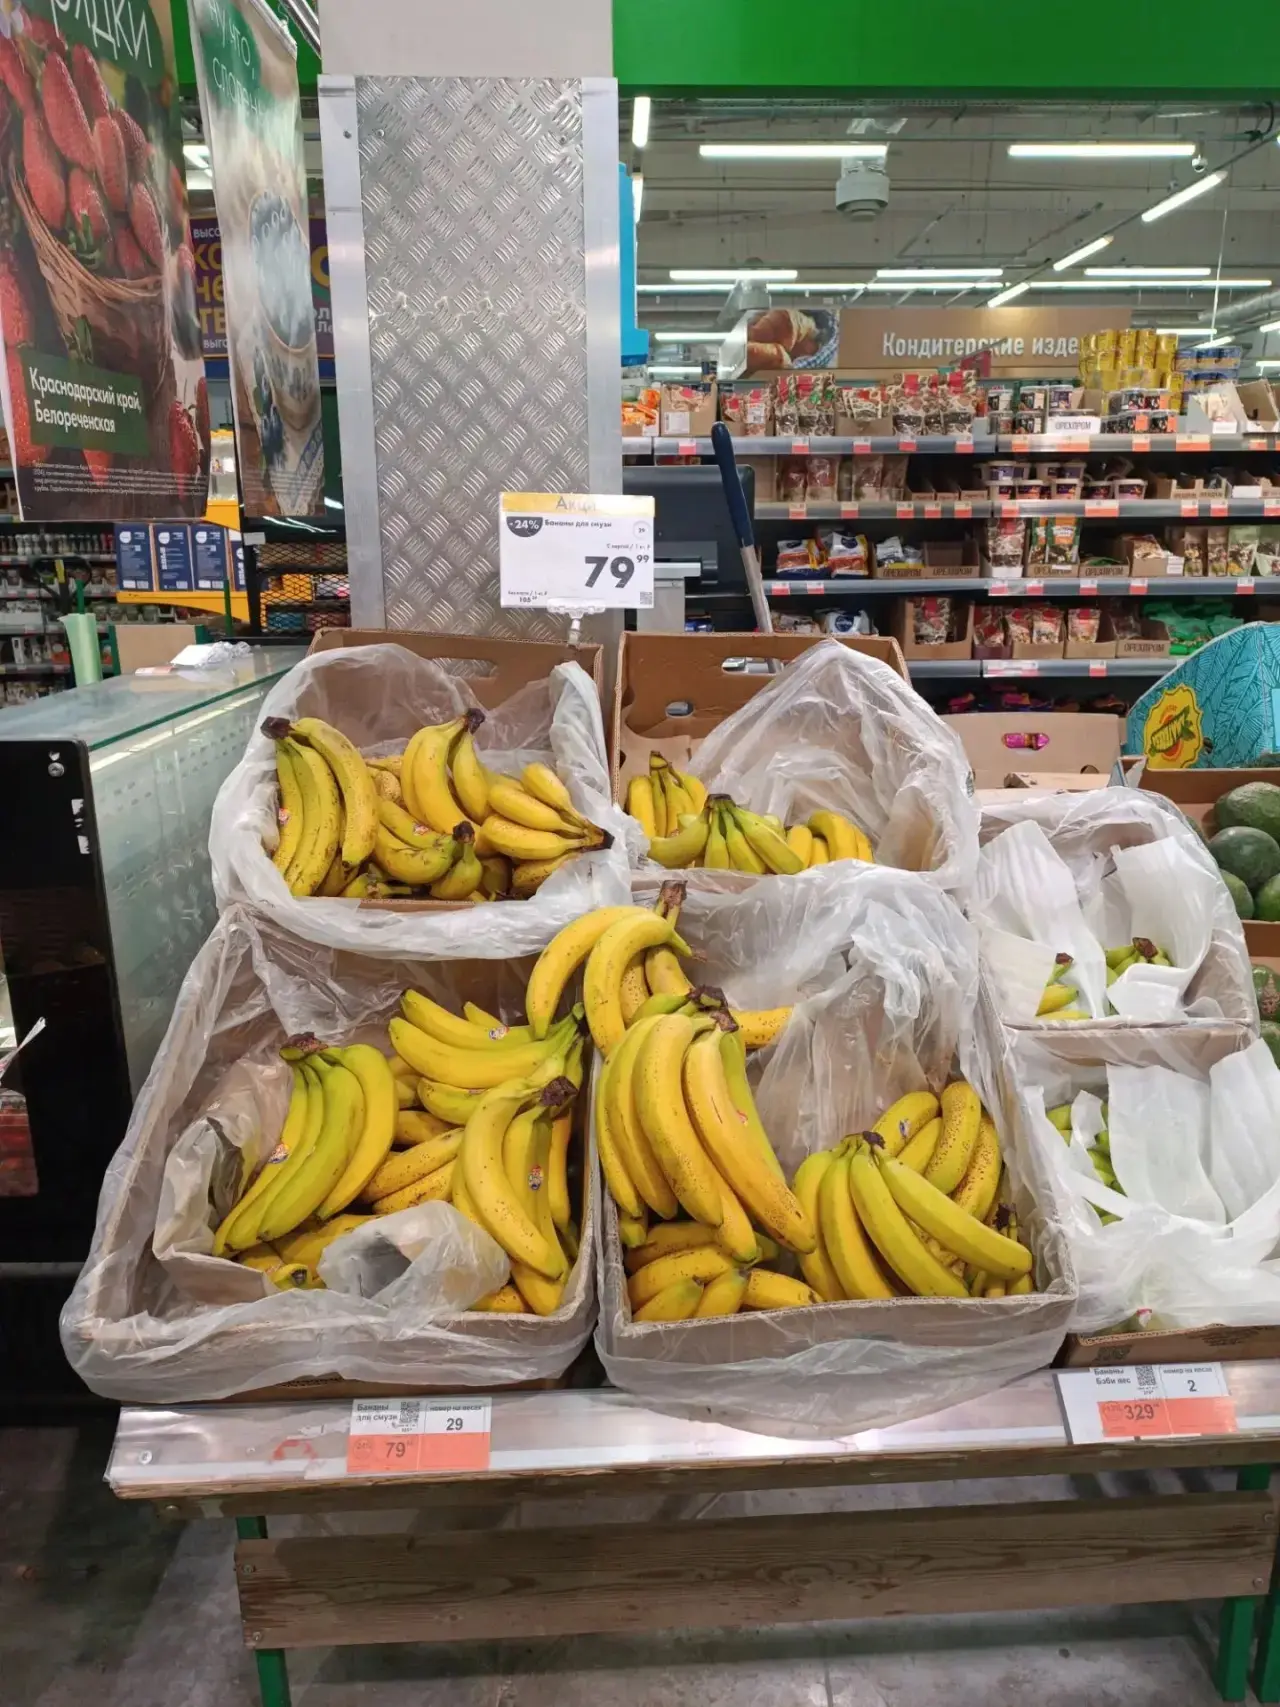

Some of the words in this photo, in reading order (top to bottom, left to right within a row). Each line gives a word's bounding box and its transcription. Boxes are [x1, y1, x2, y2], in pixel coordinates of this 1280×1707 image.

[882, 332, 1025, 358] Кондитерские
[1032, 336, 1079, 358] изде
[29, 366, 116, 407] Краснодарский
[116, 391, 143, 414] край,
[34, 400, 116, 433] Белореченская
[545, 519, 574, 527] Бананы
[636, 554, 650, 563] 99
[585, 556, 635, 588] 79
[1187, 1379, 1198, 1392] 2
[1124, 1404, 1155, 1420] 329
[446, 1417, 464, 1431] 29
[386, 1442, 406, 1458] 79
